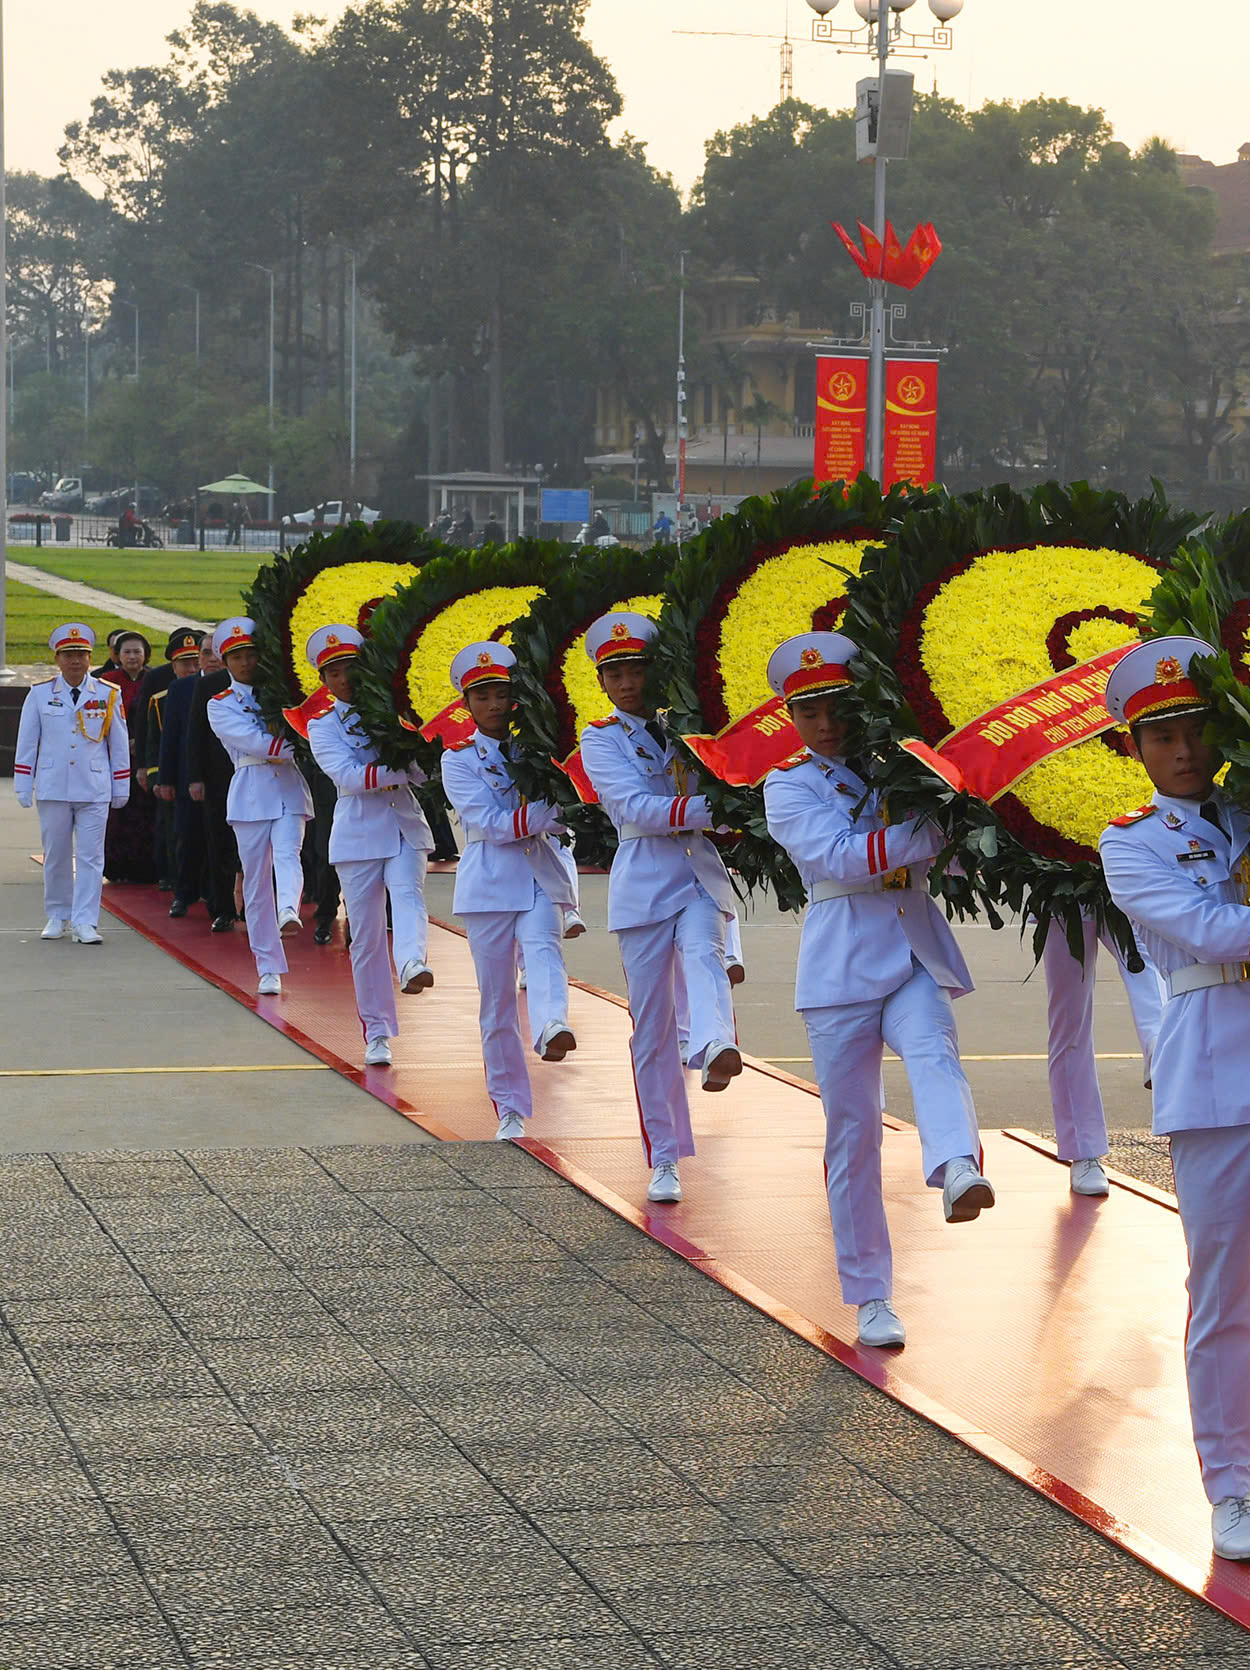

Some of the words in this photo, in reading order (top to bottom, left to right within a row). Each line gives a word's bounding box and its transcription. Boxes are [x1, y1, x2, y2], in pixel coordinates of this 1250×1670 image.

[752, 714, 786, 736] ĐỜI
[978, 720, 1019, 746] ĐỜI
[1002, 706, 1044, 728] ĐỜI
[1028, 689, 1072, 717] NHỚ
[1059, 683, 1095, 703] ƠN
[1043, 721, 1069, 743] CHỦ
[1060, 716, 1089, 734] TỊCH
